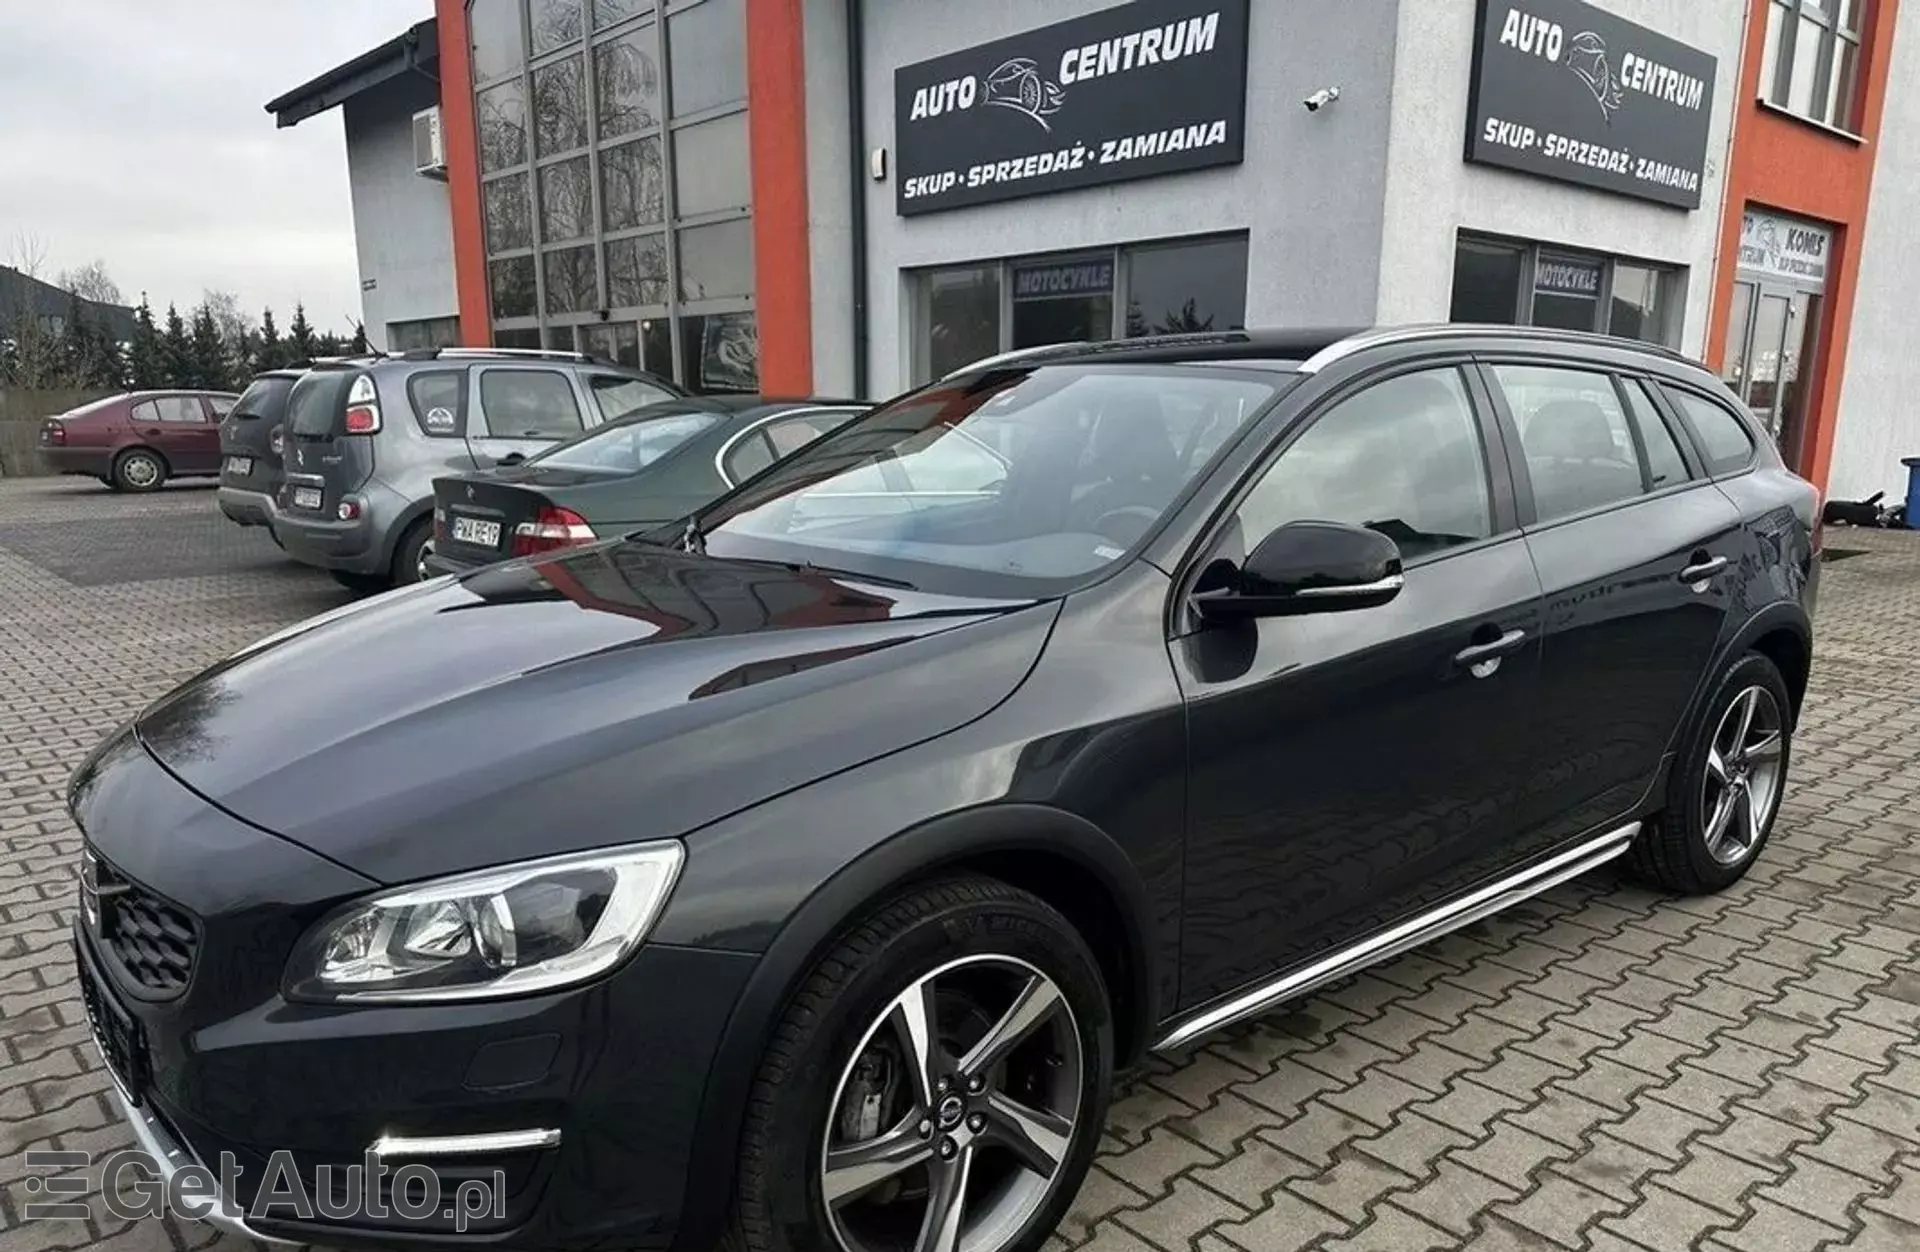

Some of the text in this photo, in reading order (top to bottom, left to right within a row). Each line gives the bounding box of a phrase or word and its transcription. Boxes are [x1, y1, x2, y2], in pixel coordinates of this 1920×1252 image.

[910, 12, 1220, 121] AUTO CENTRUM
[1500, 8, 1705, 110] AUTO CENTRUM
[904, 120, 1227, 199] SKUP SPRZEDAŻ ZAMIANA
[1483, 117, 1700, 192] SKUP SPRZEDAŻ ZAMIANA
[1016, 264, 1111, 293] MOTOCYKLE
[1534, 263, 1598, 291] MOTOCYKLE
